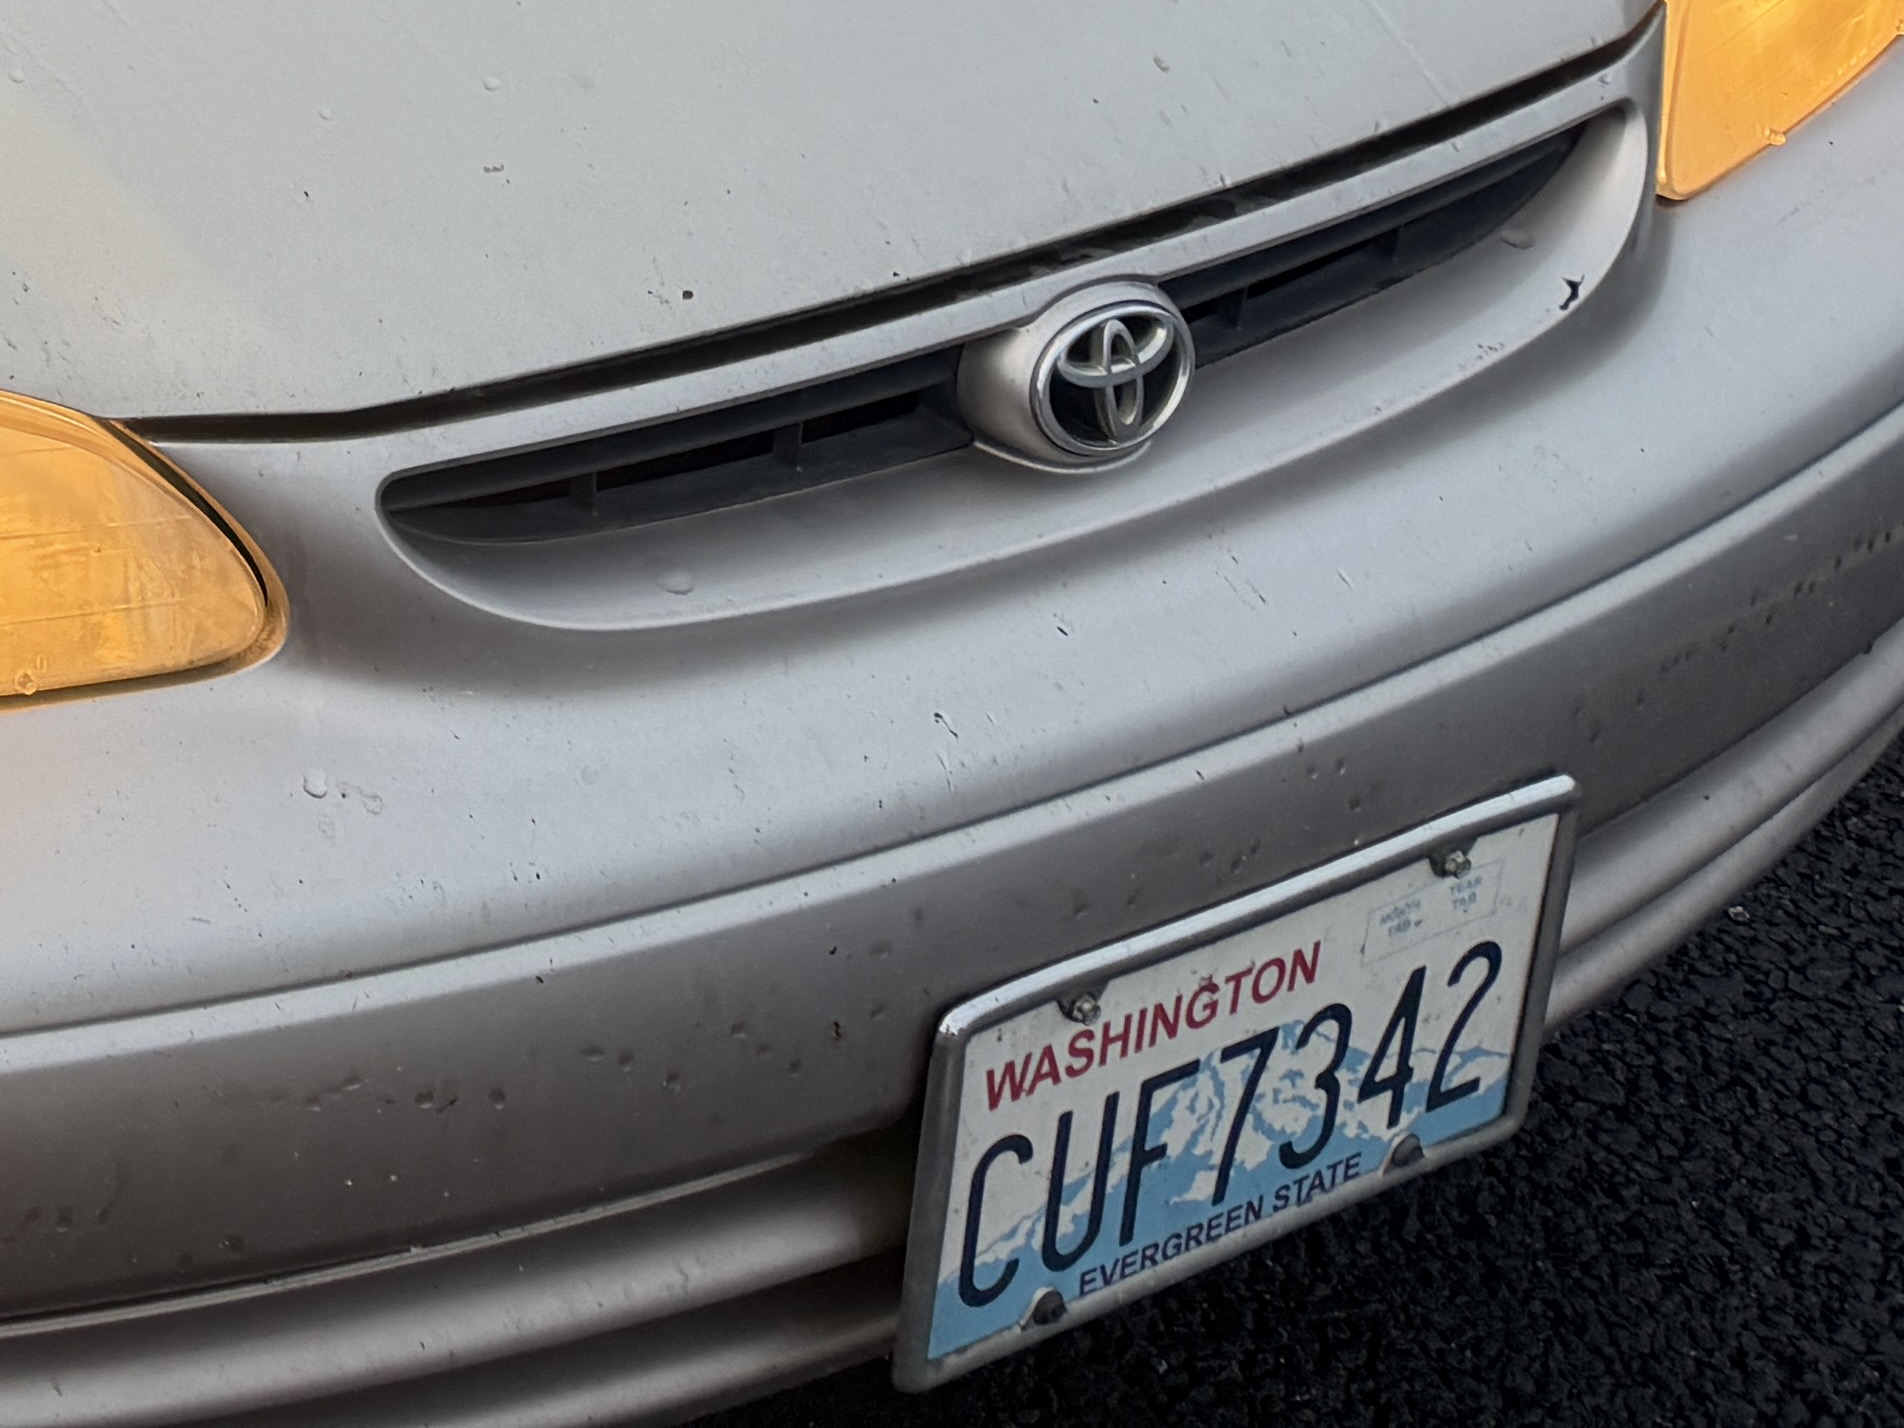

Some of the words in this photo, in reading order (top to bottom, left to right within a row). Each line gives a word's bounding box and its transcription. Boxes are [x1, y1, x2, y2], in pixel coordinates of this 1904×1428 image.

[985, 940, 1322, 1110] WASHINGTON
[958, 941, 1502, 1308] CUF7342
[1078, 1194, 1265, 1297] EVERGREEN
[1272, 1152, 1362, 1214] STATE
